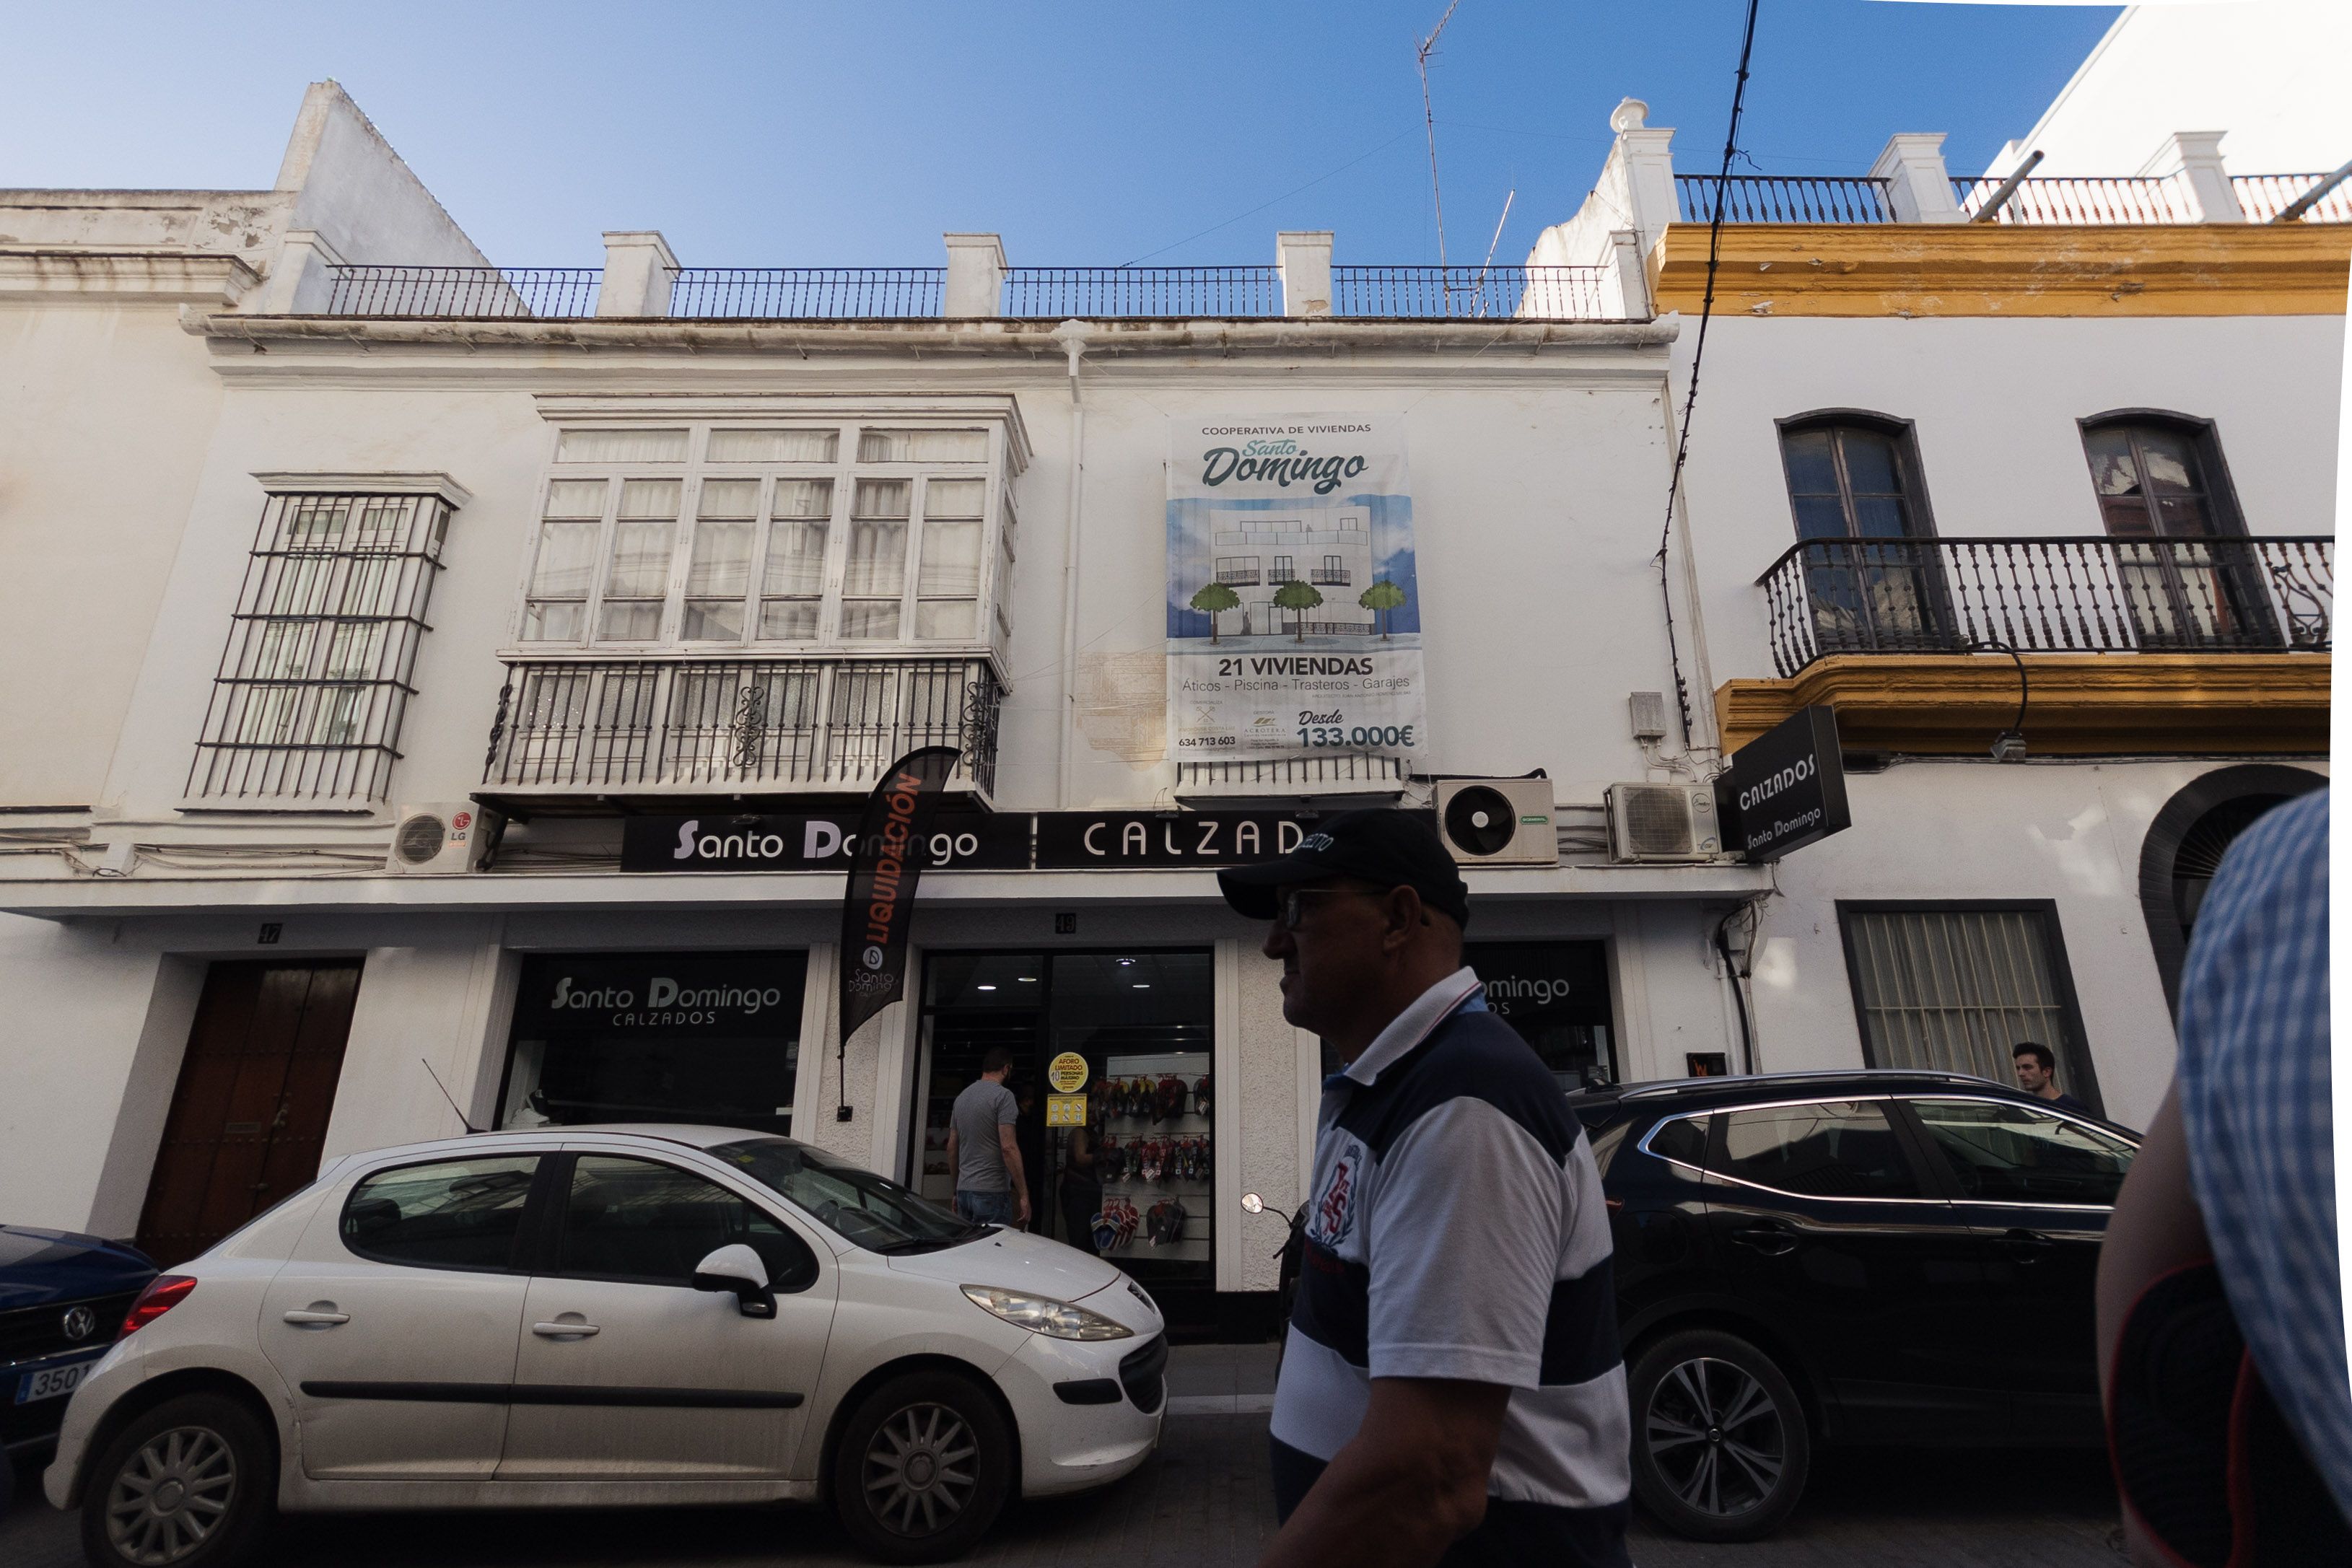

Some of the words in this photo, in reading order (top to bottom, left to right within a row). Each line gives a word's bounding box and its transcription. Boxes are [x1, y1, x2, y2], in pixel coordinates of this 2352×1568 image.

[1202, 426, 1284, 435] COOPERATIVA
[1308, 424, 1371, 433] VIVIENDAS
[1242, 439, 1299, 457] Santo
[1202, 447, 1369, 495] Domingo
[1219, 659, 1242, 676] 21
[1251, 657, 1373, 676] VIVIENDAS
[1182, 678, 1220, 692] Áticos
[1235, 679, 1278, 691] Piscina
[1292, 678, 1350, 691] Trasteros
[1363, 675, 1409, 691] Garajes
[1299, 709, 1344, 726] Desde
[1179, 738, 1197, 747] 634
[1199, 737, 1216, 746] 713
[1218, 736, 1236, 745] 603
[1296, 724, 1415, 748] 133.000€
[1739, 753, 1815, 810] CALZADOS
[451, 832, 465, 841] LG
[1083, 821, 1304, 854] CALZAD
[1748, 830, 1772, 850] Santo
[1775, 808, 1821, 837] Domingo
[673, 820, 783, 859] Santo
[803, 820, 979, 865] Domngo
[866, 772, 923, 945] LIQUIDACIÓN
[1056, 915, 1075, 932] 49
[855, 968, 894, 984] Santo
[551, 977, 634, 1009] Santo
[648, 977, 780, 1014] Domingo
[1481, 975, 1570, 1004] mingo
[613, 1011, 714, 1026] CALZADOS
[1052, 1071, 1059, 1081] 10
